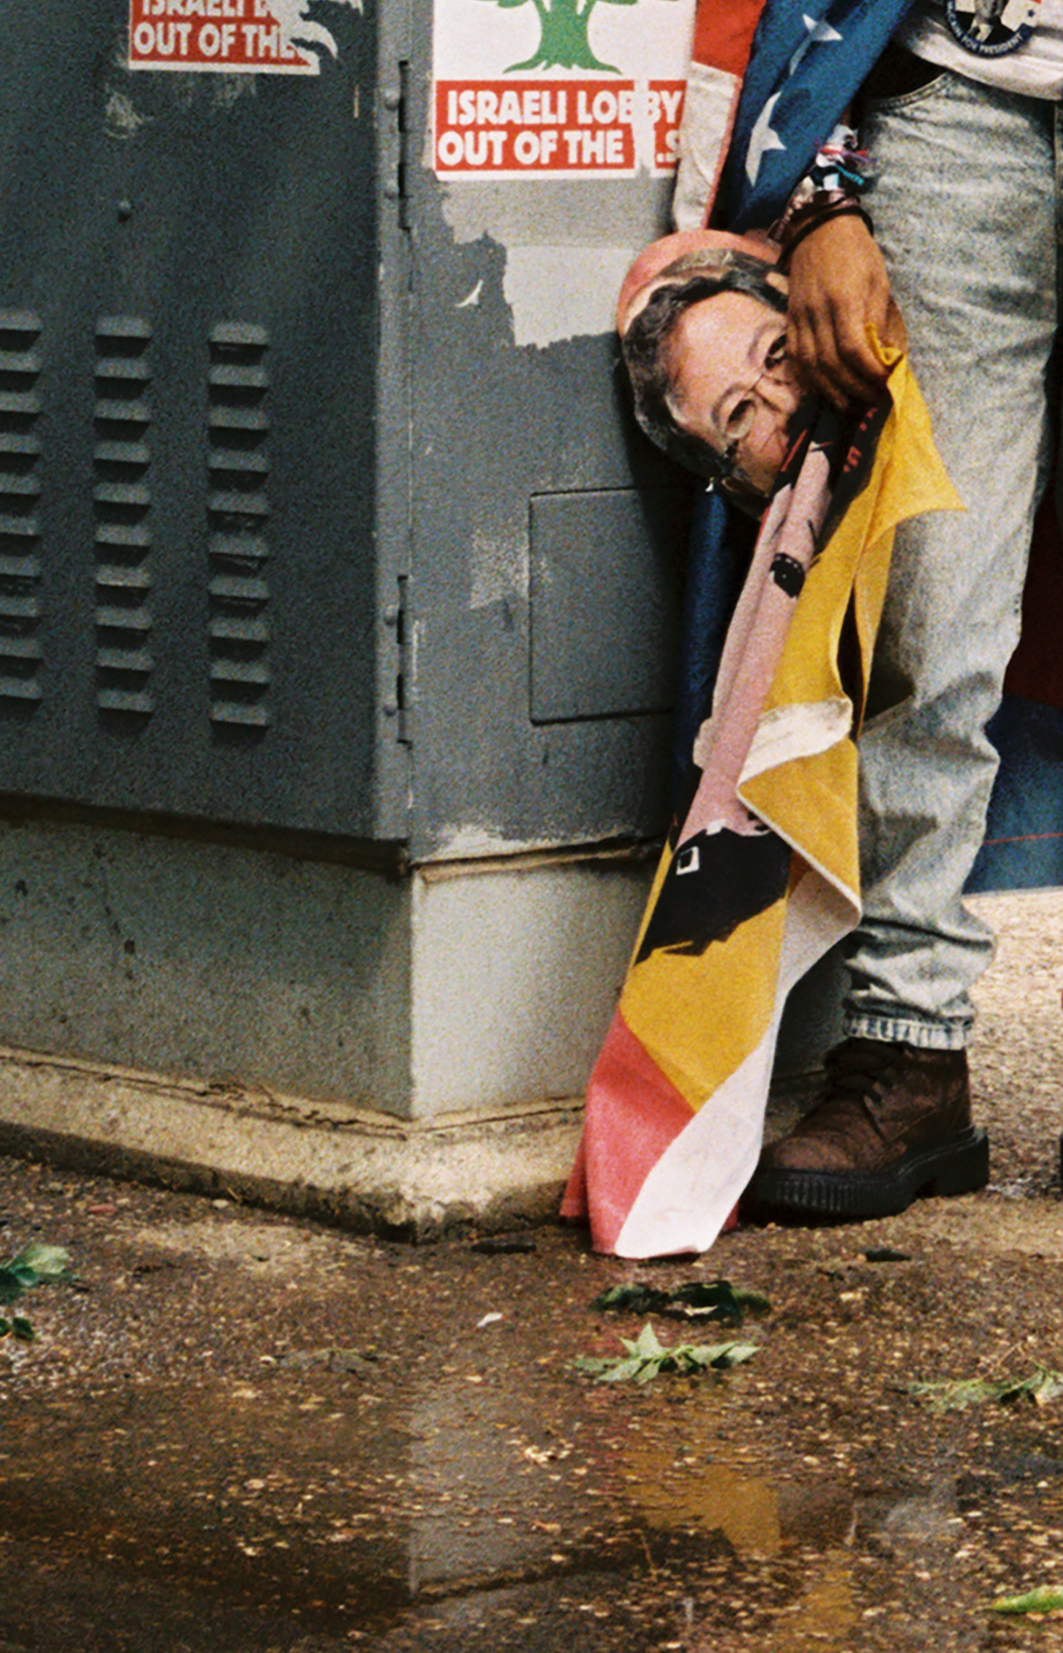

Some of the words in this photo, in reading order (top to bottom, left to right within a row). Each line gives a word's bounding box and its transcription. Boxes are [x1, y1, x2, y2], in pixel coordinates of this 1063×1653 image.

[133, 21, 192, 55] OUT
[198, 23, 237, 57] OF
[447, 90, 567, 125] ISRAELI
[577, 90, 683, 125] LOBBY
[437, 130, 508, 165] OUT
[513, 130, 558, 164] OF
[563, 130, 625, 164] THE
